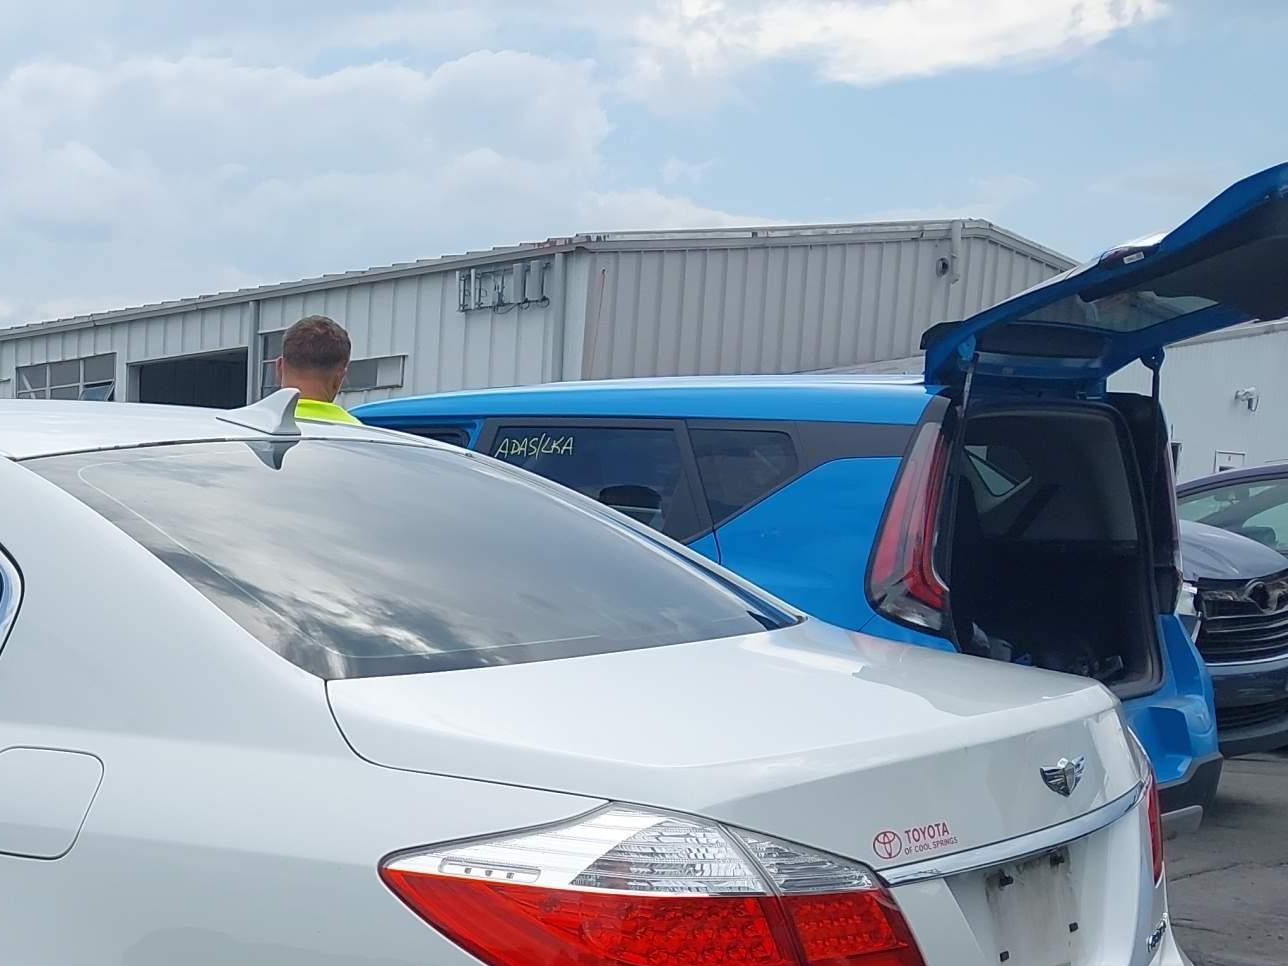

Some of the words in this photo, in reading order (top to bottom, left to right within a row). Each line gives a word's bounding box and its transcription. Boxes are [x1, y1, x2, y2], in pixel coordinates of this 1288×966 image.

[494, 433, 574, 460] ADAS/LKA
[904, 822, 950, 844] TOYOTA
[904, 847, 913, 855] OF
[914, 843, 932, 853] COOL
[932, 836, 958, 849] SPRINGS
